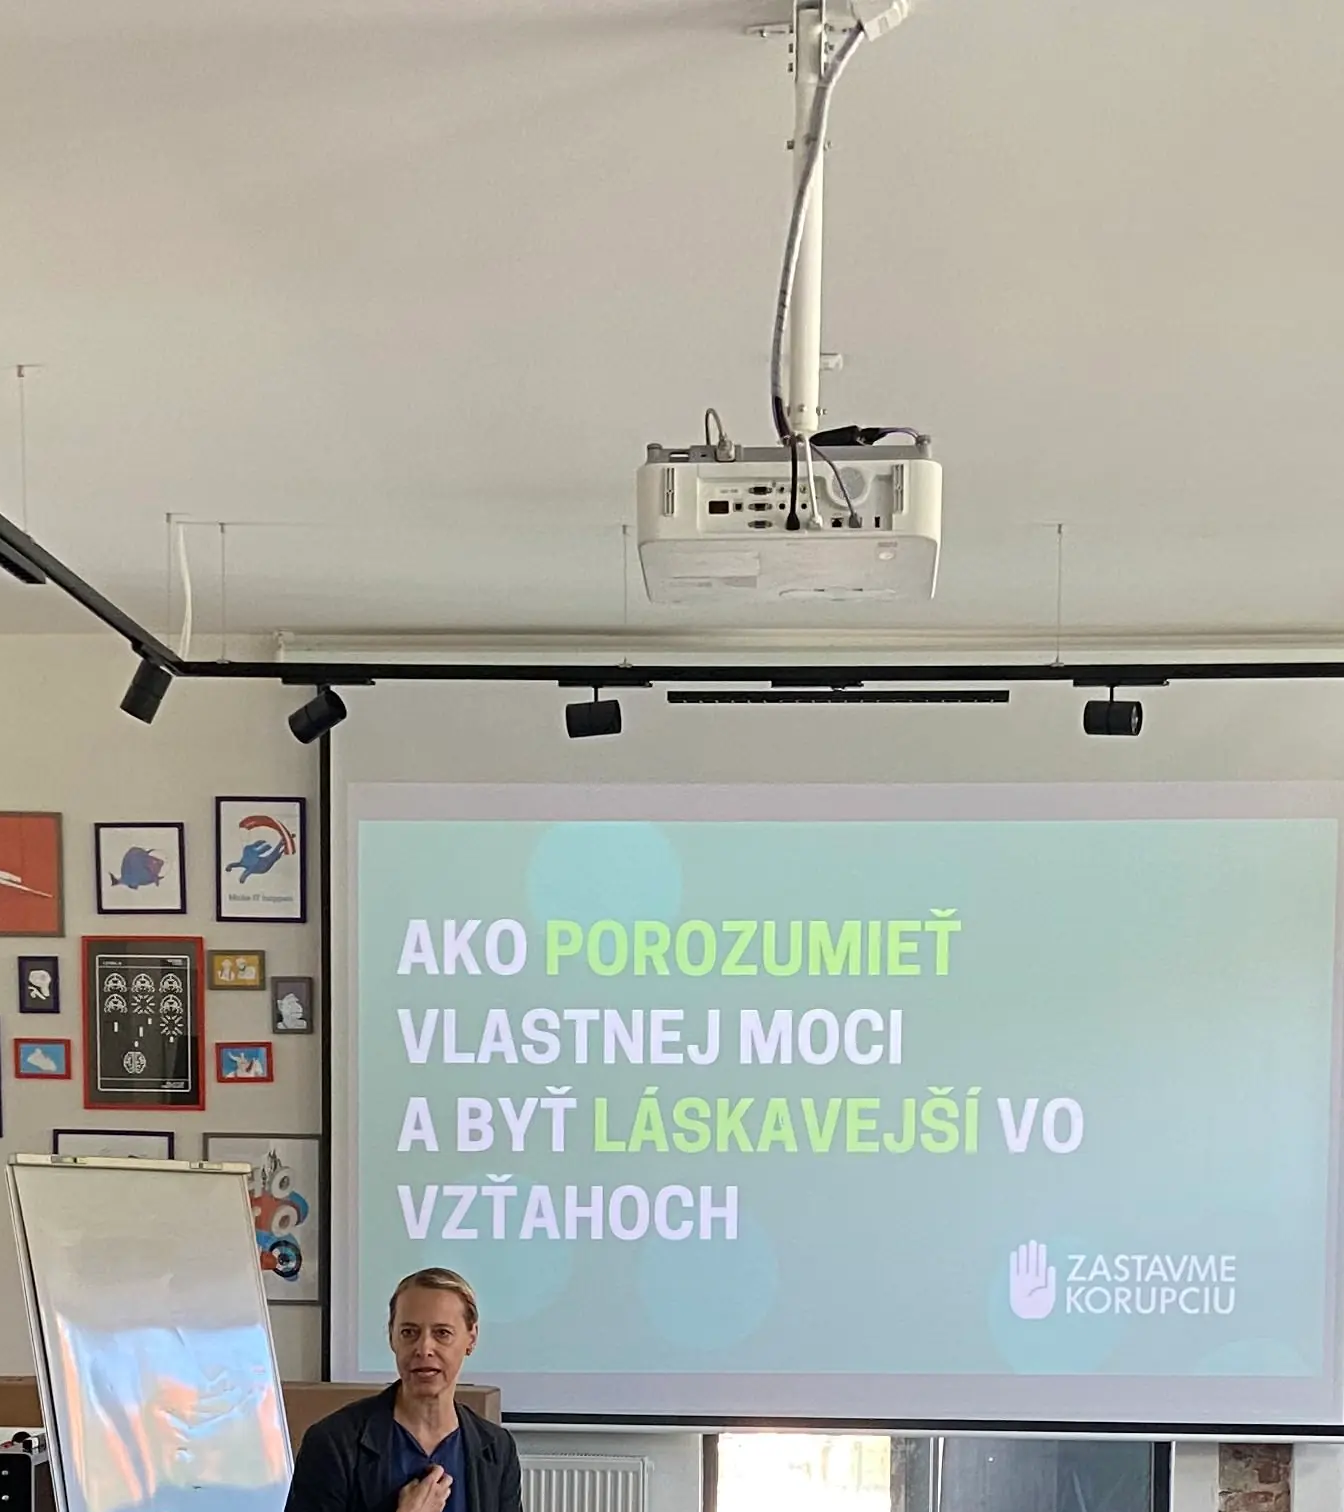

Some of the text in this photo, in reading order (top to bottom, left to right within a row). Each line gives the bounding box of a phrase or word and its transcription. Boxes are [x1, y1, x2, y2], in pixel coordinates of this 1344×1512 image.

[396, 909, 962, 976] AKO POROZUMIEŤ
[397, 1007, 904, 1065] VLASTNEJ MOCI
[397, 1086, 1084, 1153] A BYŤ LÁSKAVEJŠÍ VO
[397, 1174, 739, 1241] VZŤAHOCH
[1067, 1254, 1236, 1284] ZASTAVME
[1067, 1285, 1236, 1315] KORUPCIU
